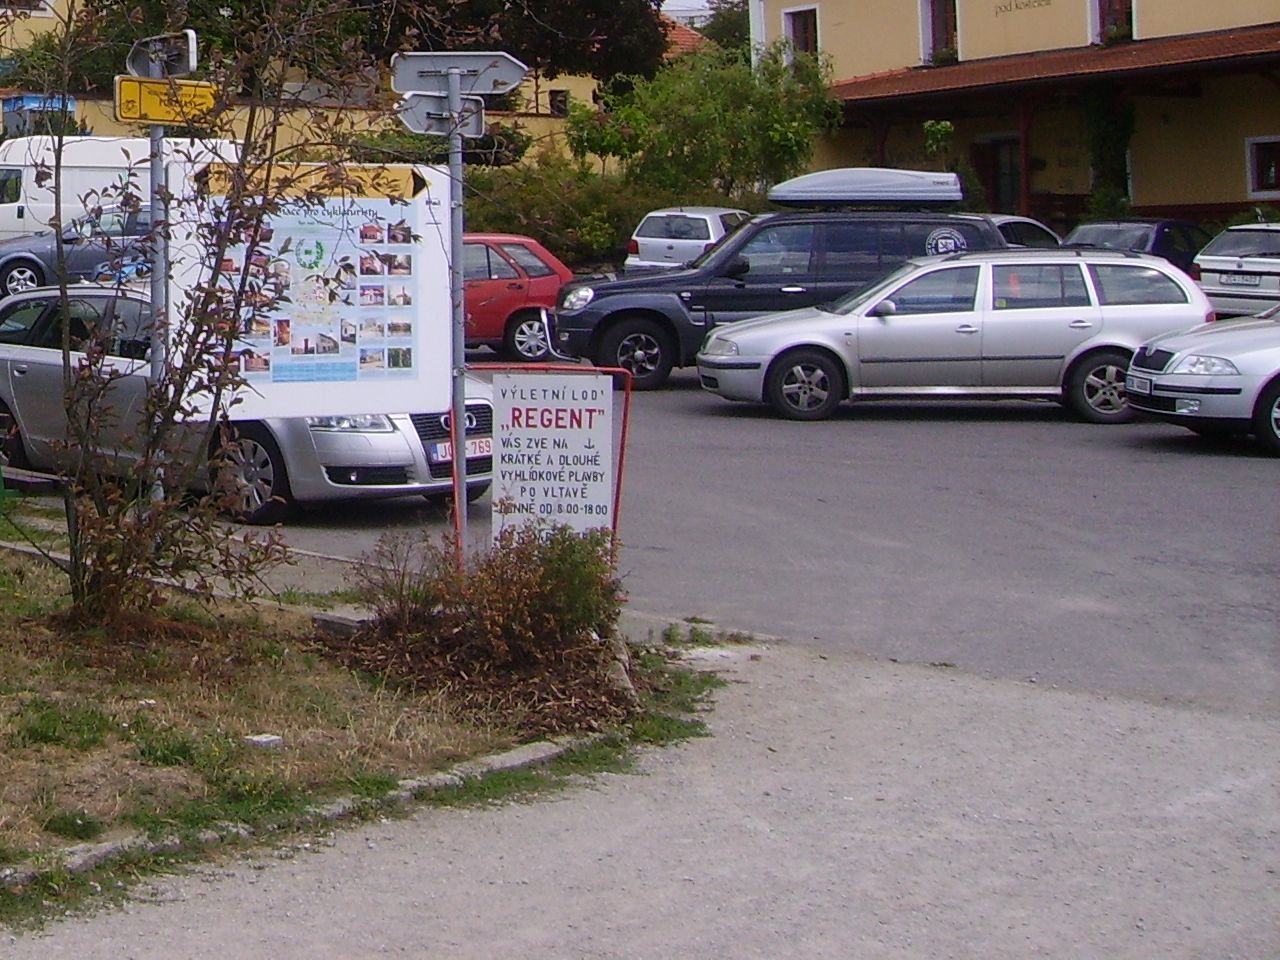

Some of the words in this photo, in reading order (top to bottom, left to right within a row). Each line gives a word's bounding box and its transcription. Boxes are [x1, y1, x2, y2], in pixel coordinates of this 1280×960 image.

[501, 386, 566, 401] VÝLETNÍ
[501, 433, 521, 449] VÁS
[526, 438, 548, 449] ZVE
[553, 438, 568, 449] NA
[500, 450, 541, 465] KRÁTKÉ
[547, 454, 554, 466] A
[559, 451, 601, 466] DLOUHÉ
[501, 466, 565, 482] VYHLÍDKOVÉ
[569, 471, 605, 483] PLAVBY
[520, 486, 536, 498] PO
[543, 483, 588, 498] VLTAVĚ
[540, 503, 552, 514] OD
